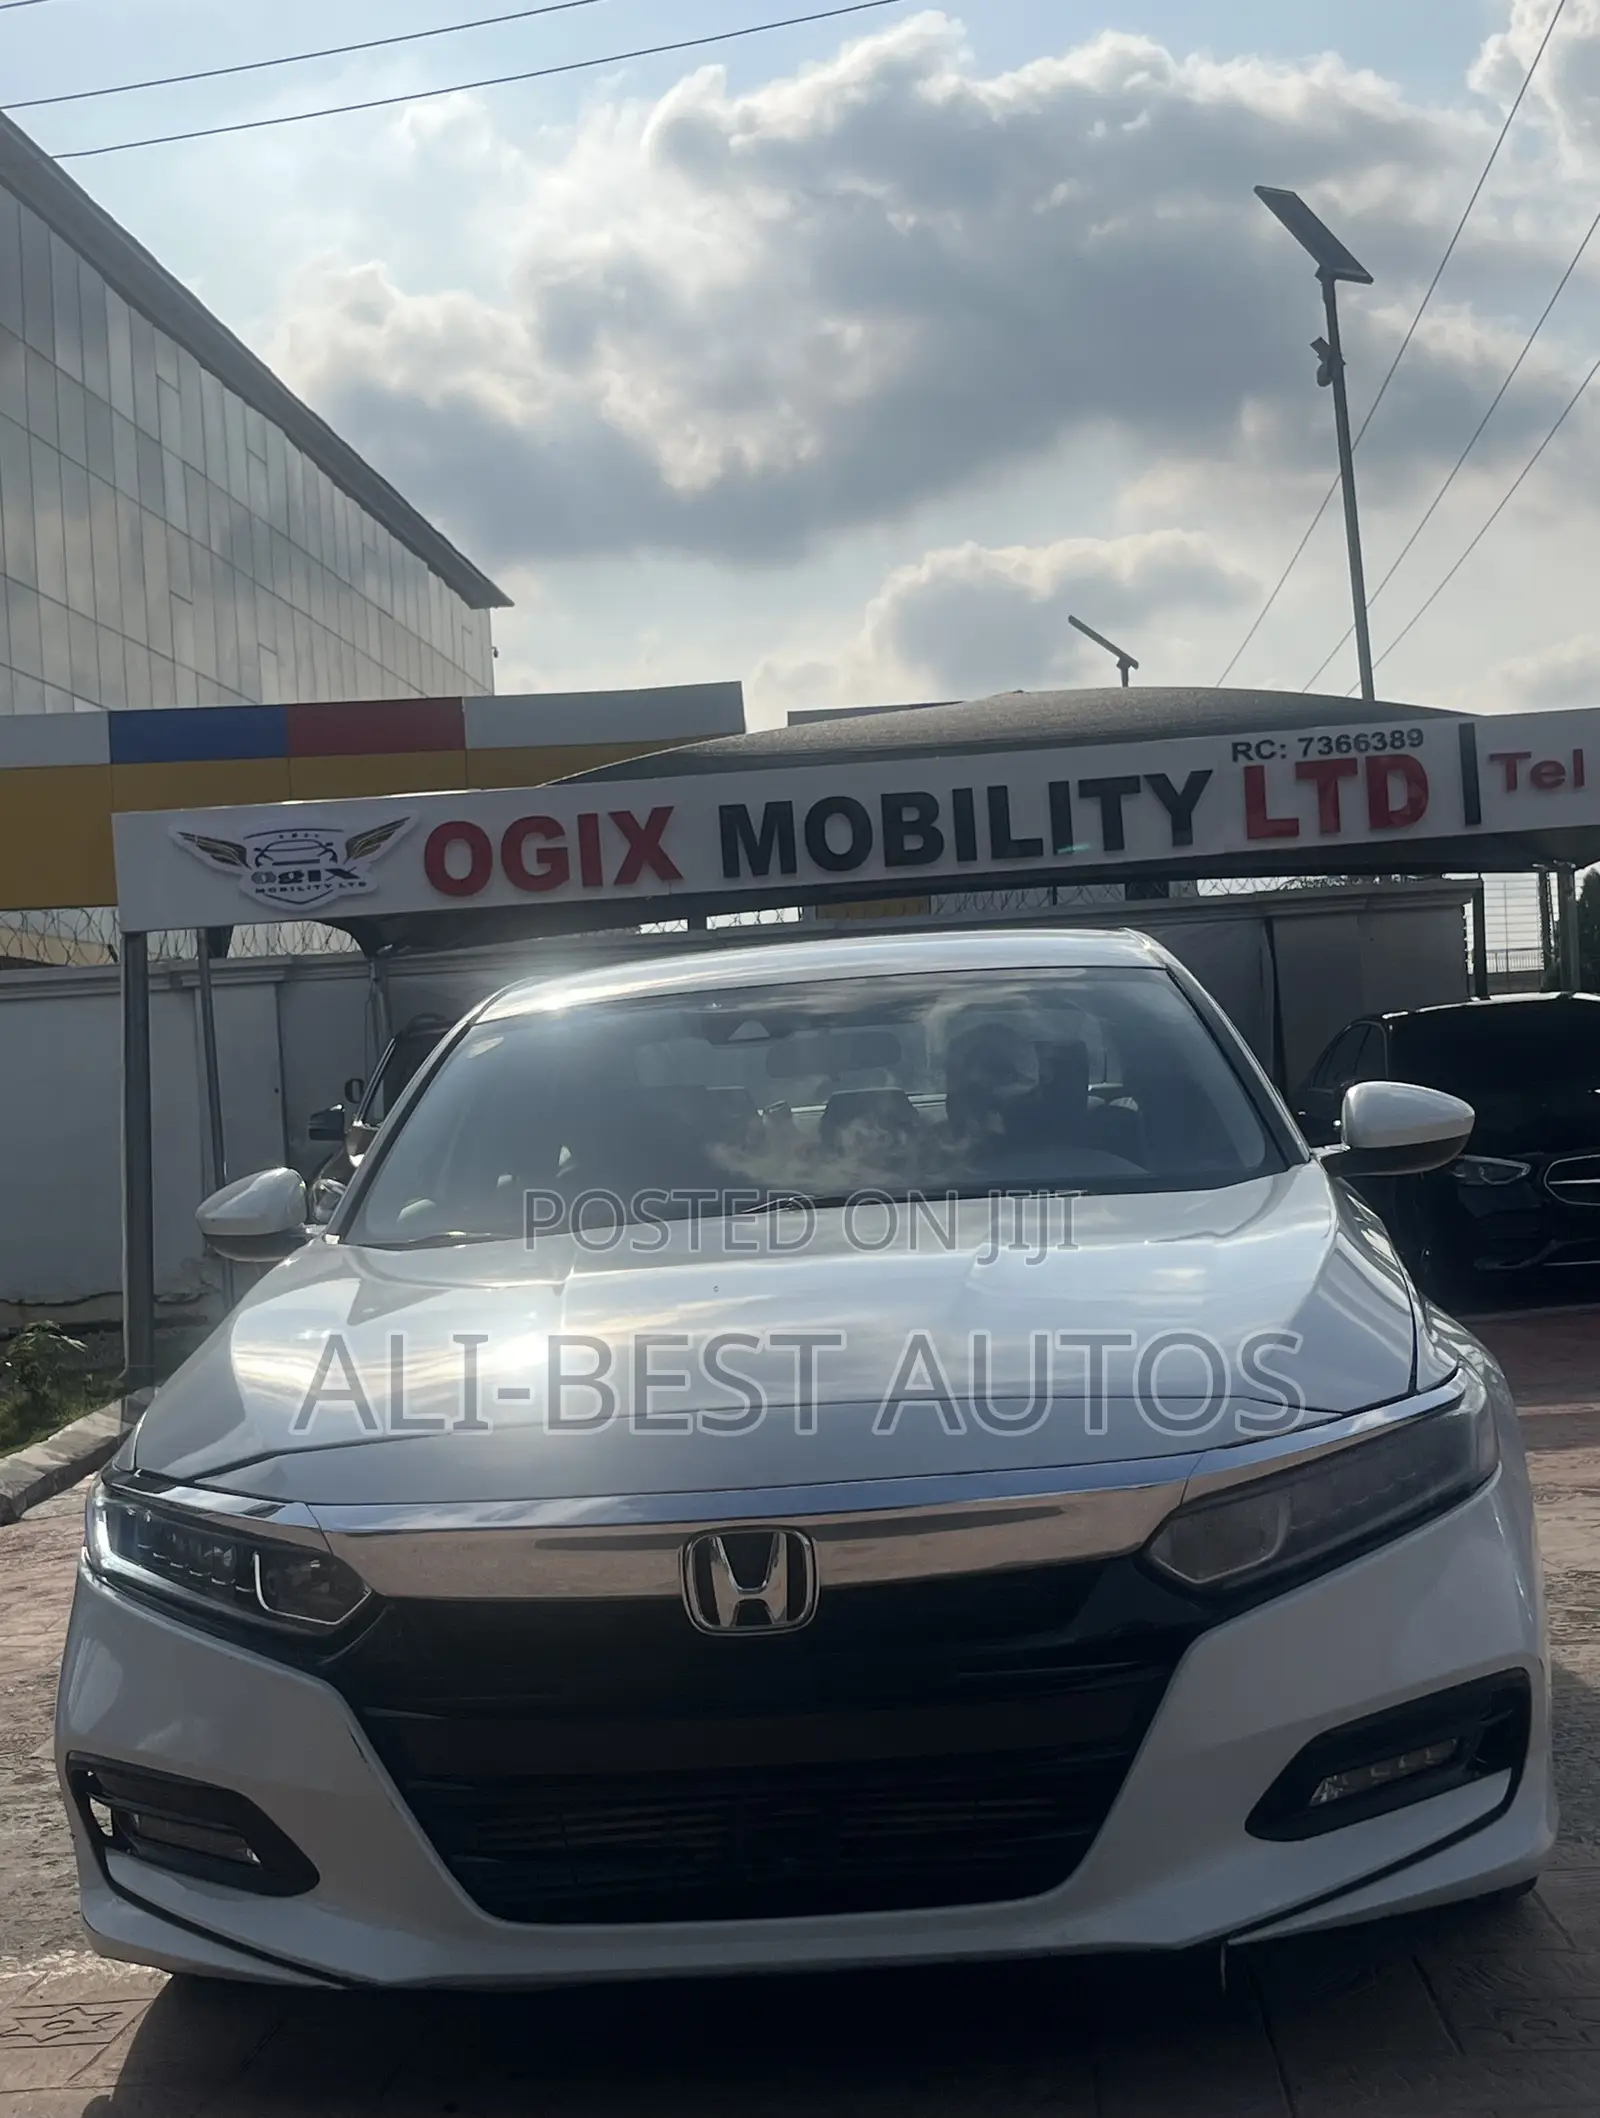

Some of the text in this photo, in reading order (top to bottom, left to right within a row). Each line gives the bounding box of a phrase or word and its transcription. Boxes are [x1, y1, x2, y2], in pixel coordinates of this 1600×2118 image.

[1231, 728, 1424, 762] RC: 7366389
[1489, 749, 1585, 792] Tel
[424, 754, 1430, 897] OGIX MOBILITY LTD
[255, 882, 333, 894] MOBILITY
